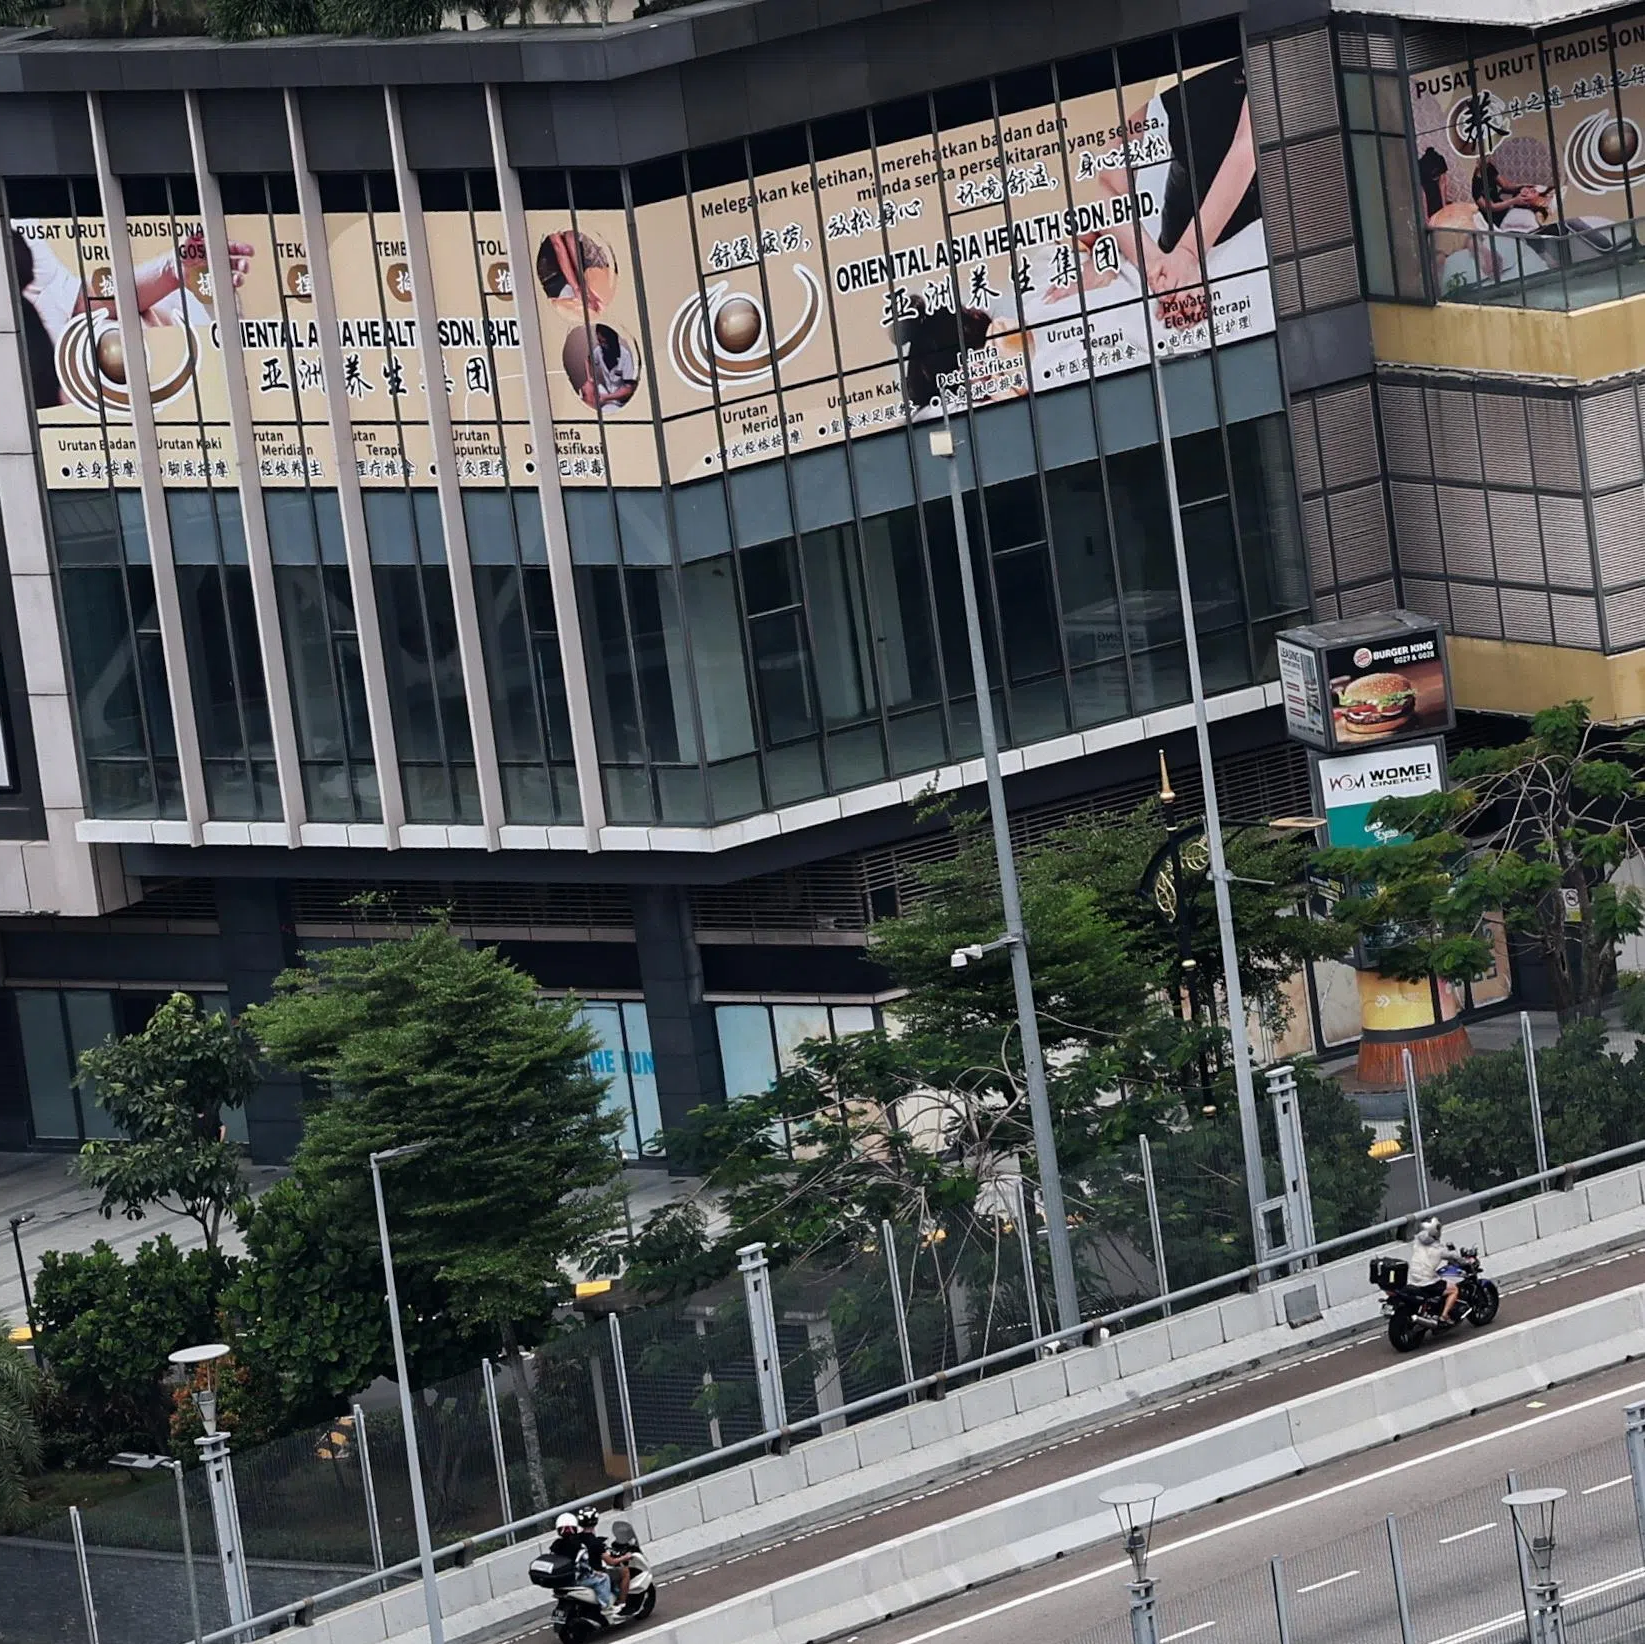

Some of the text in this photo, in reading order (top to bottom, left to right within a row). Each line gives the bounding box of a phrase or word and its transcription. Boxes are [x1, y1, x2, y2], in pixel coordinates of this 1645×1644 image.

[1485, 53, 1535, 81] URUT
[1067, 130, 1105, 154] yang
[701, 187, 787, 219] Melegakan
[881, 139, 977, 174] merehatkan
[66, 223, 105, 239] URUT
[127, 222, 205, 238] RADISIONA
[179, 244, 206, 260] GOS
[277, 243, 306, 258] TEK
[376, 241, 407, 257] TEMB
[477, 240, 508, 256] TOL
[836, 191, 1160, 292] ORIENTAL ASIA HEALTH SDN. BHD.
[881, 236, 1120, 326] 亚洲养生集团
[356, 320, 416, 347] HEALT
[437, 319, 481, 346] SDN.
[876, 381, 902, 396] Kak
[722, 405, 768, 424] Urutan
[253, 431, 284, 442] rutan
[554, 429, 581, 440] imfa
[58, 440, 96, 451] Urutan
[1373, 645, 1409, 660] BURGER
[1409, 640, 1434, 653] KING
[1368, 763, 1431, 781] WOMEI
[1370, 774, 1432, 788] CINEPLEX
